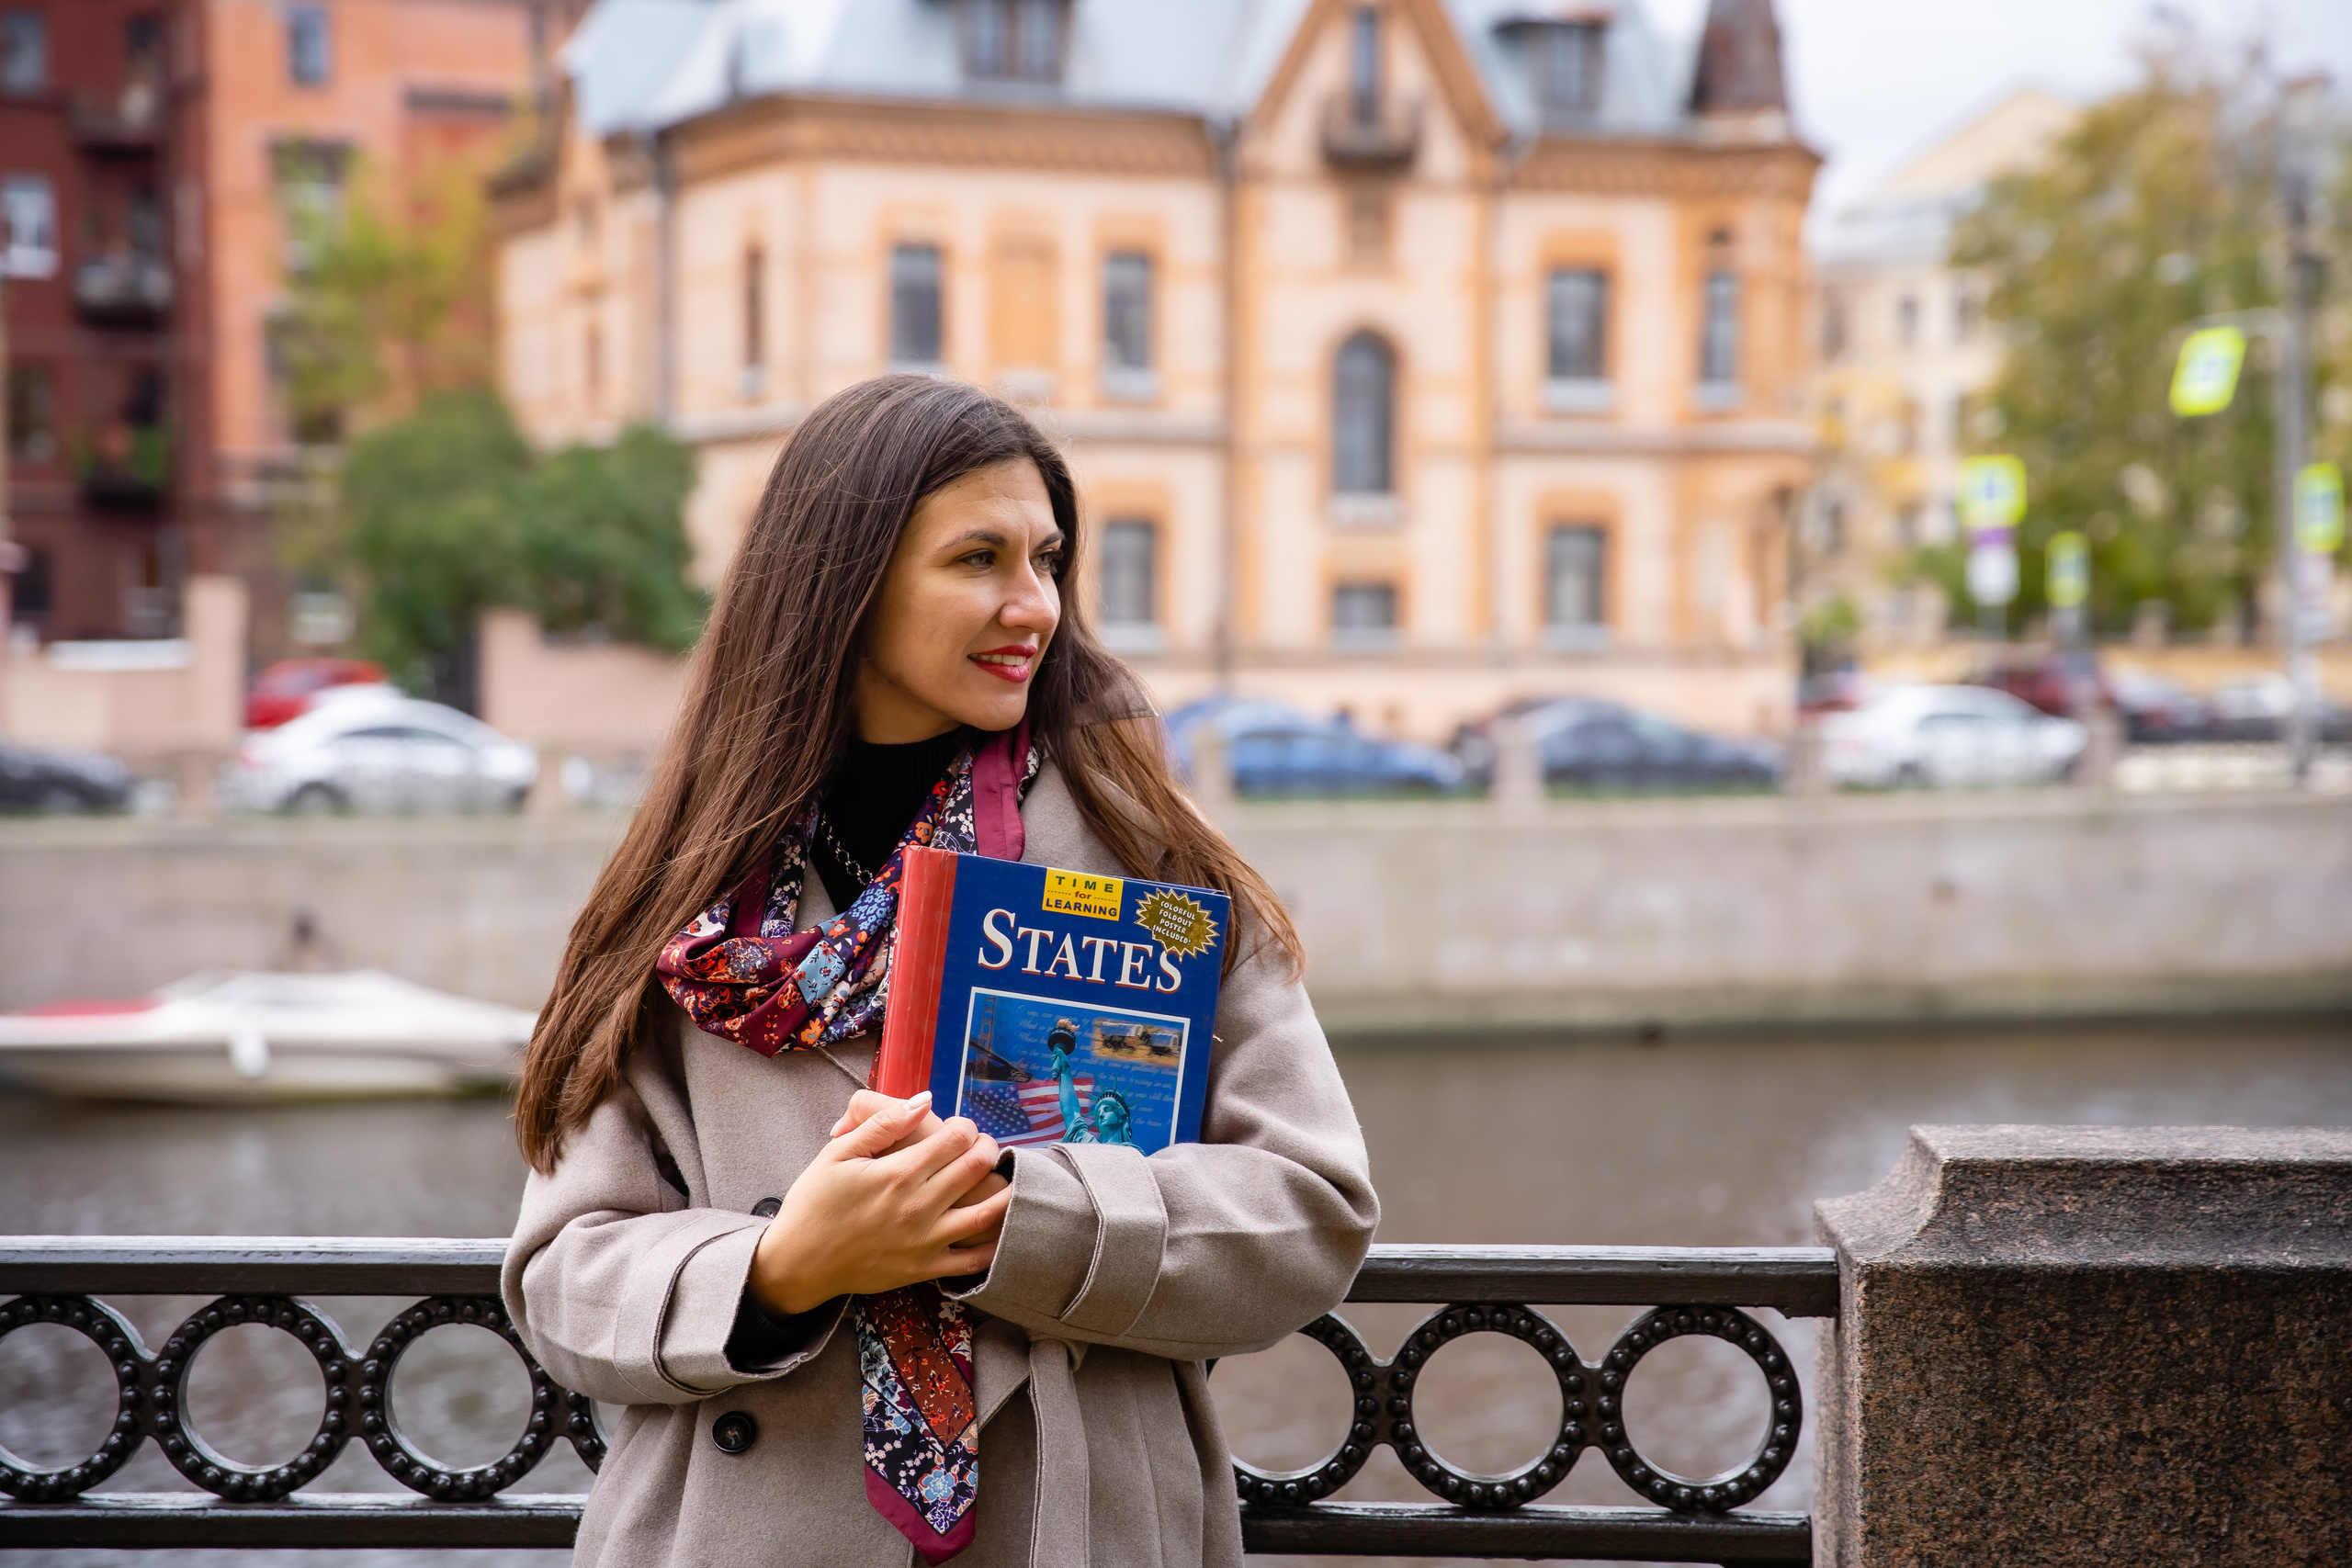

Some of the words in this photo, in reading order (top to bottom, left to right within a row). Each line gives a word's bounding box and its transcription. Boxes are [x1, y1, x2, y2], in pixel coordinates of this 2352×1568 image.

[1056, 875, 1114, 893] TIME
[1074, 890, 1092, 899] for
[1046, 897, 1117, 917] LEARNING
[1160, 900, 1196, 920] COLORFUL
[1159, 909, 1193, 928] FOLDOUT
[1159, 919, 1186, 934] POSTER
[1152, 924, 1192, 945] INCLUDED!
[978, 908, 1182, 995] STATES
